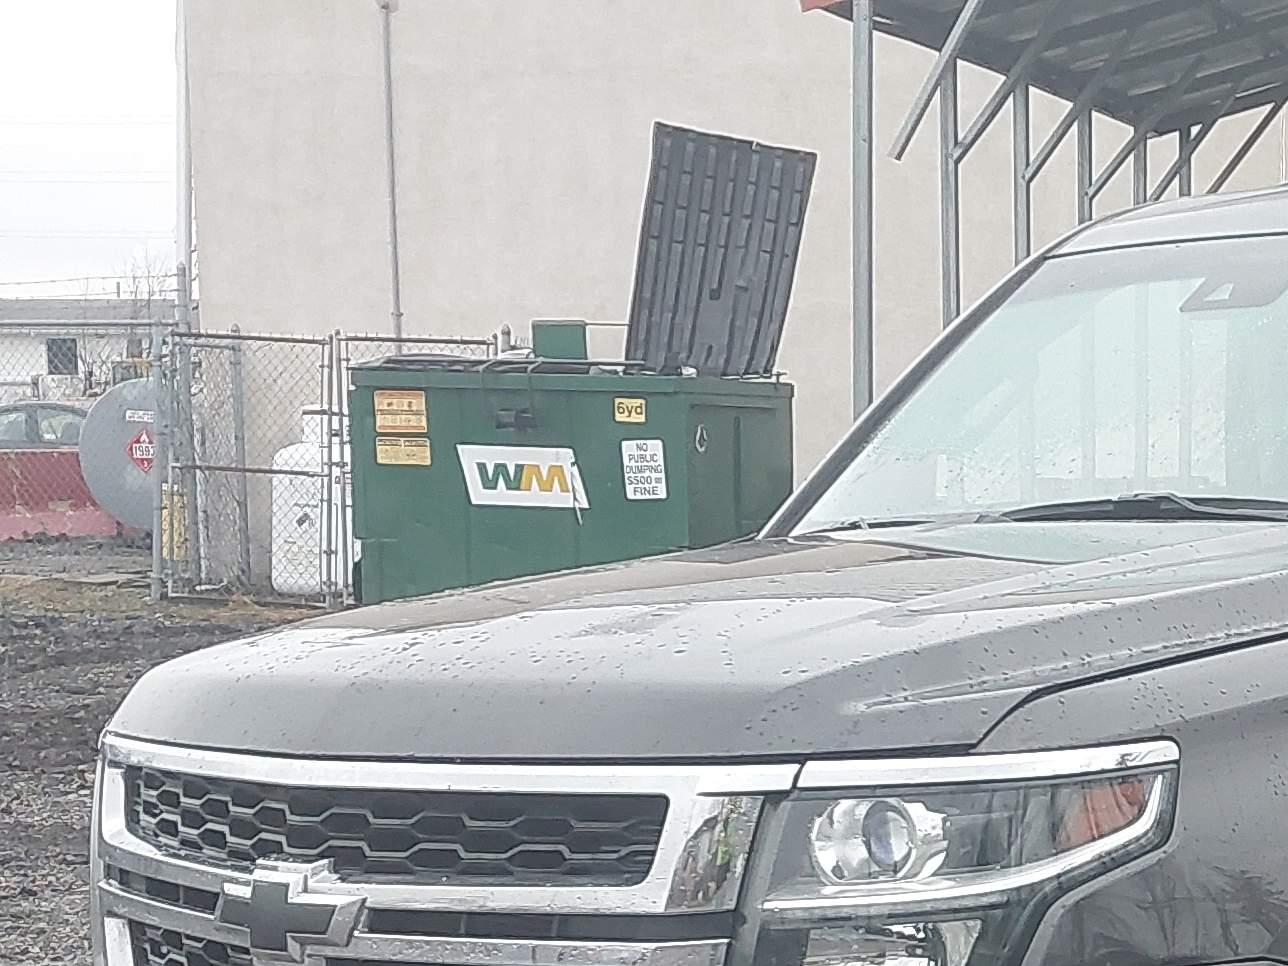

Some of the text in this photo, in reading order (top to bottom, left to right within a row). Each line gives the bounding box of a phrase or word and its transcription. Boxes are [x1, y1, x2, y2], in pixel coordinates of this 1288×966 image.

[617, 402, 643, 417] 6yd
[636, 443, 648, 452] NO
[628, 454, 657, 463] PUBLIC
[626, 465, 662, 474] DUMPING
[475, 461, 570, 493] WM
[633, 487, 659, 496] FINE
